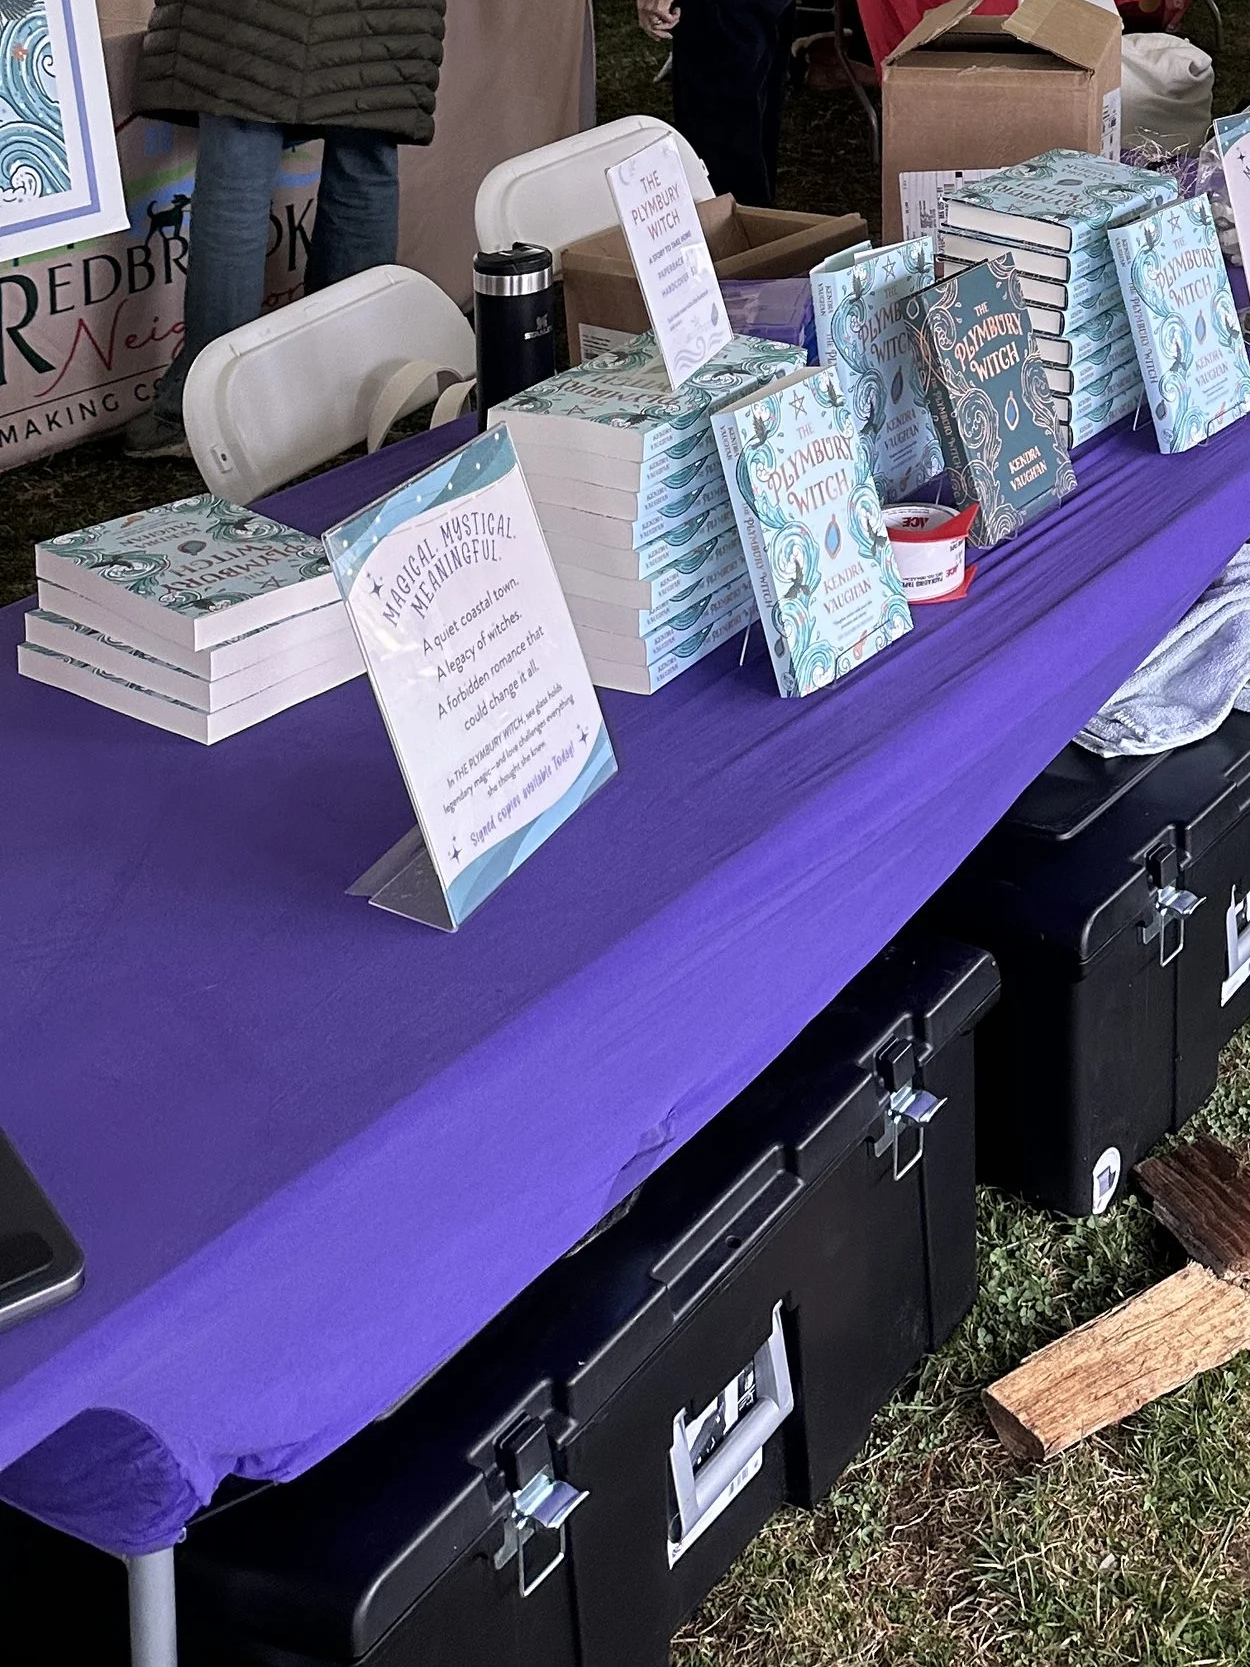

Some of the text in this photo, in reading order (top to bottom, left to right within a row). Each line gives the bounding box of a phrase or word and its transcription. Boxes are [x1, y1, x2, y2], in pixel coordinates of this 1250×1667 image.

[640, 170, 661, 193] THE
[631, 183, 680, 226] PLYMBURY
[647, 208, 681, 241] WITCH
[1155, 245, 1217, 297] PLYMBURY
[884, 285, 898, 300] THE
[973, 301, 990, 315] THE
[1169, 274, 1213, 311] WITCH
[859, 299, 903, 357] PLYMB
[954, 311, 1024, 373] PLYMBURY
[969, 341, 1021, 383] WITCH
[1145, 346, 1159, 384] WITCH
[1194, 347, 1224, 372] KENDRA
[1195, 360, 1230, 388] VAUGHAN
[0, 392, 120, 448] MAKING
[796, 421, 815, 440] THE
[884, 422, 920, 452] VAUGHAN
[885, 407, 916, 434] KENDRA
[767, 435, 855, 506] PLYMBURY
[1008, 445, 1042, 474] KENDRA
[1009, 459, 1049, 491] VAUGHAN
[787, 468, 849, 518] WITCH
[902, 516, 930, 530] ACE
[160, 542, 306, 595] PLYMBURY
[171, 544, 273, 578] WITCH
[383, 511, 516, 628] MAGICAL. MYSTICAL.
[410, 538, 502, 620] MEANINGFUL.
[743, 515, 765, 572] PLYMBURY
[759, 572, 774, 609] WITCH
[823, 561, 865, 596] KENDRA
[422, 577, 520, 657] A quiet coastal town.
[823, 578, 872, 615] VAUGHAN
[436, 608, 523, 683] A legacy of witches.
[437, 625, 545, 721] A forbidden romance that
[463, 658, 540, 732] could change it all.
[442, 785, 474, 814] legendary
[506, 743, 519, 759] love
[518, 719, 547, 750] challenges
[546, 693, 575, 723] everything
[446, 683, 563, 789] In THE PLYMBURY WITCH, sea glass holds
[469, 740, 576, 848] Signed copies available Today!
[487, 784, 498, 798] she
[497, 761, 522, 787] thought
[520, 756, 532, 768] she
